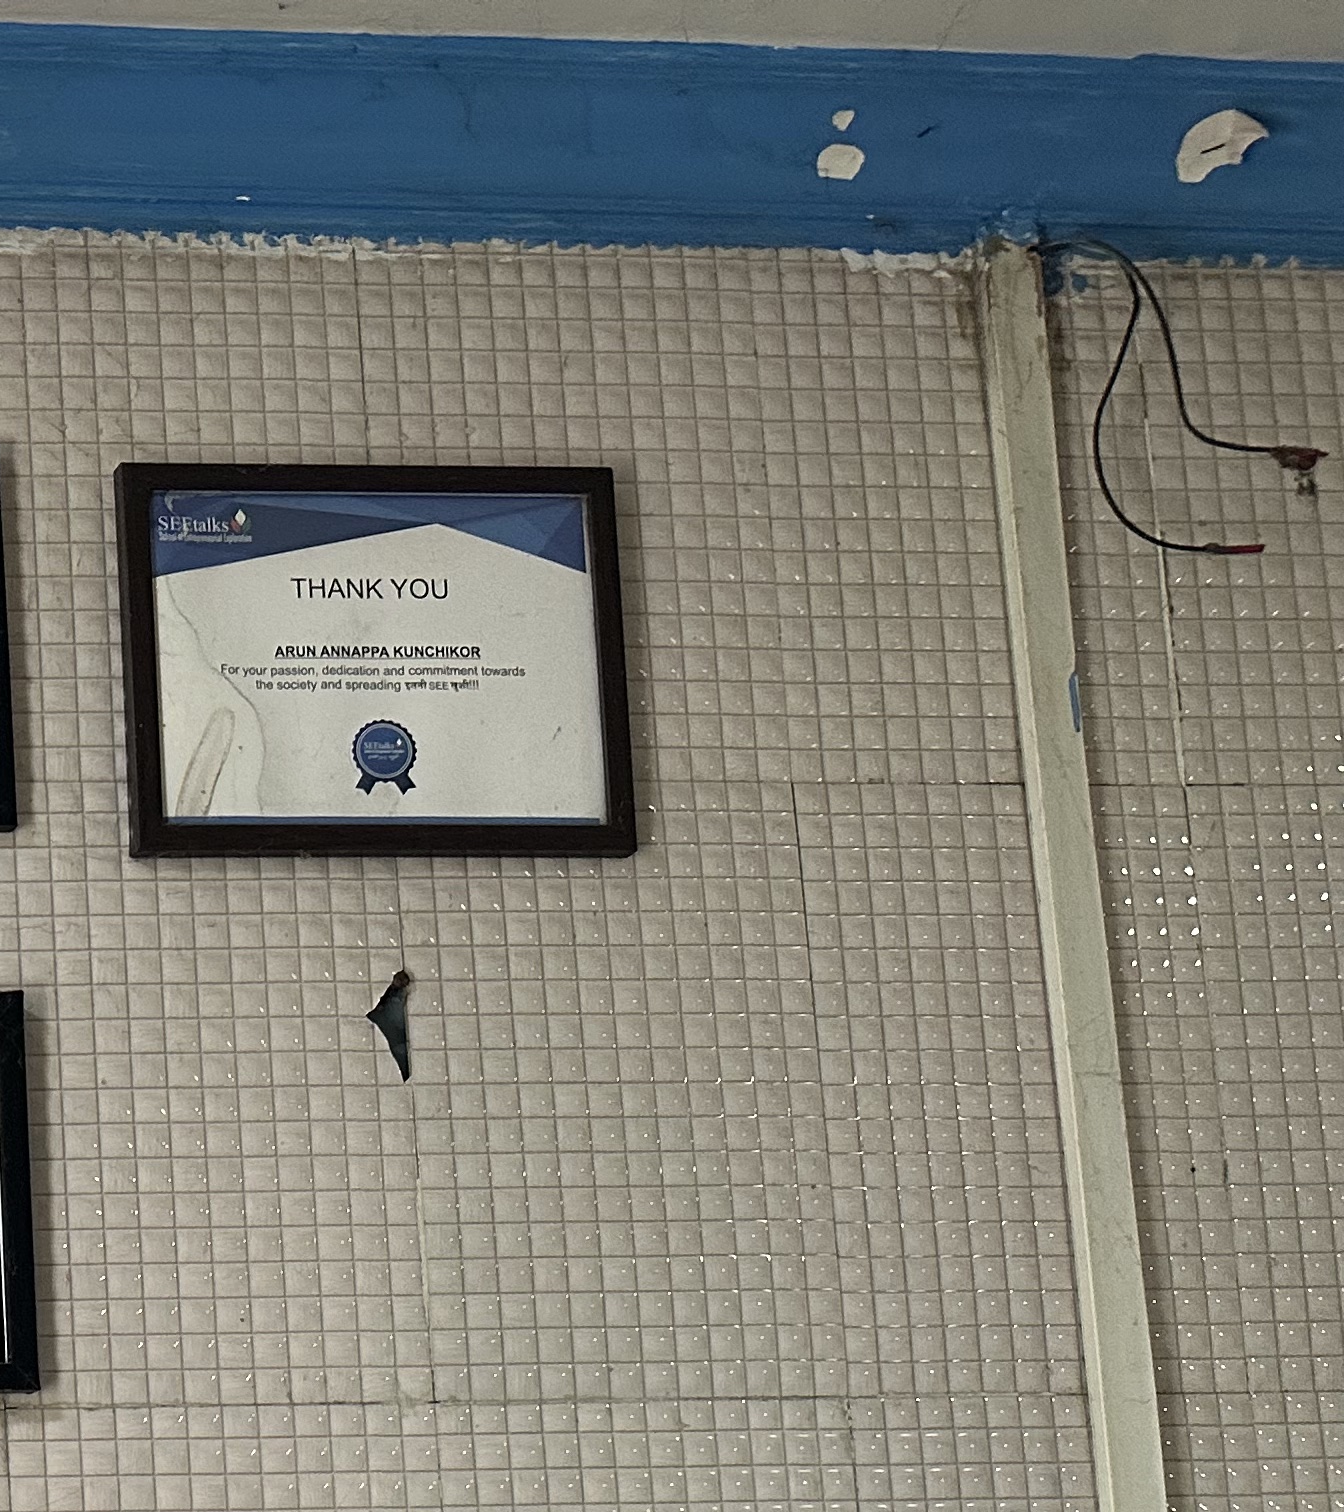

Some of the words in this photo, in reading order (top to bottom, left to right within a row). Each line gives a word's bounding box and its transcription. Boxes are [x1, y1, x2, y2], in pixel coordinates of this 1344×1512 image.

[158, 516, 230, 532] SEEtalks
[291, 578, 383, 599] THANK
[390, 579, 449, 599] YOU
[275, 646, 316, 658] ARUN
[320, 646, 389, 658] ANNAPPA
[393, 646, 481, 658] KUNCHIKOR
[221, 664, 240, 674] For
[242, 666, 267, 677] your
[271, 665, 318, 677] passion,
[322, 666, 380, 676] dedication
[384, 666, 405, 676] and
[408, 666, 478, 676] commitment
[481, 666, 525, 677] towards
[256, 680, 273, 690] the
[277, 680, 317, 692] society
[321, 680, 342, 690] and
[346, 680, 401, 692] spreading
